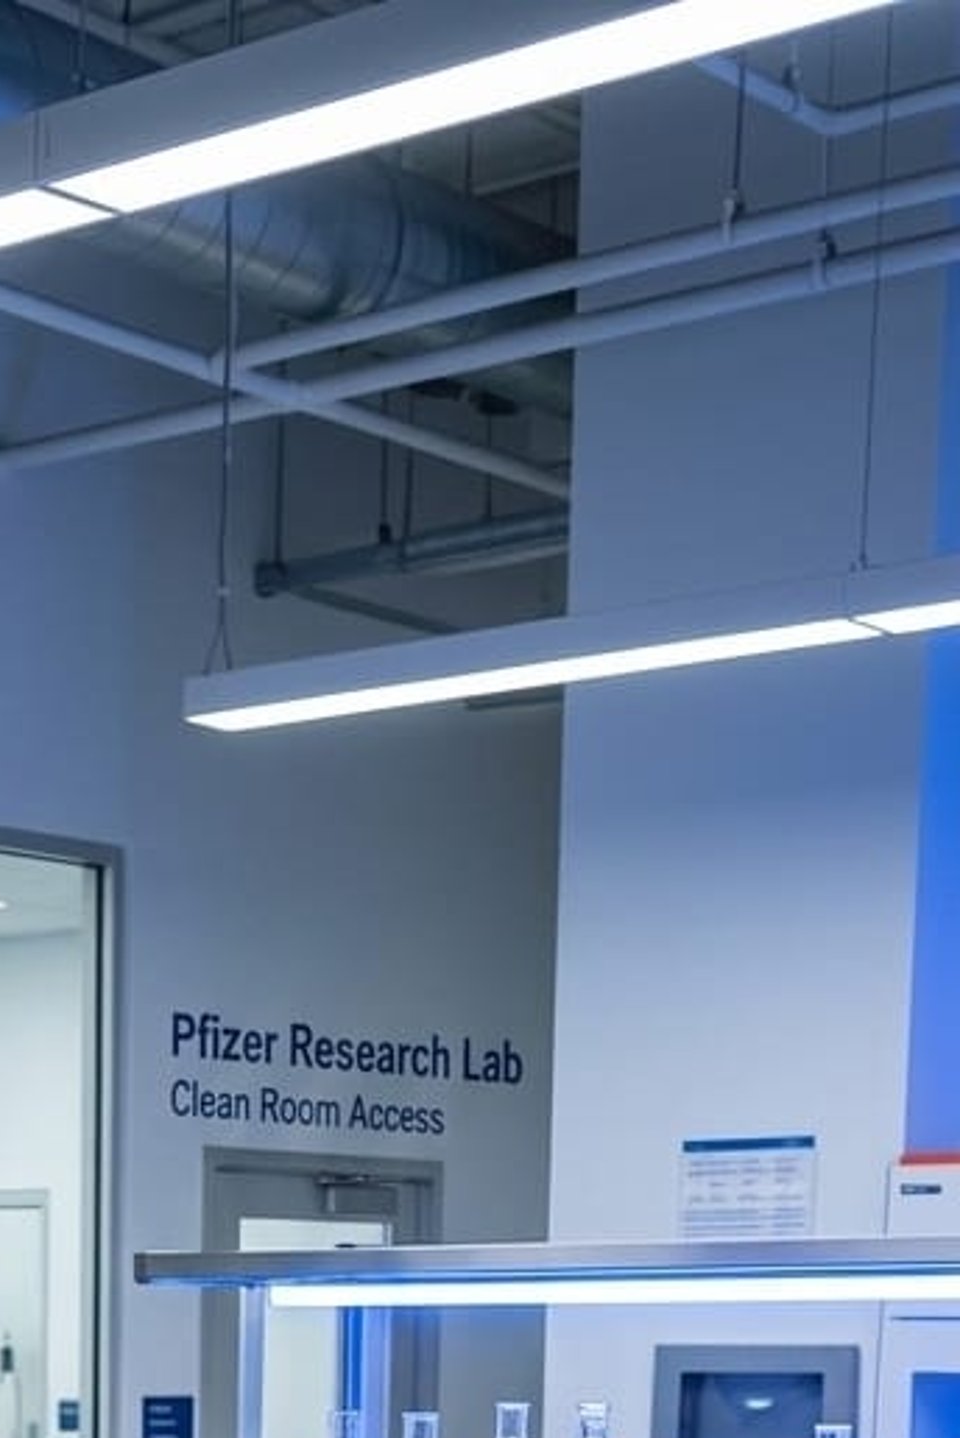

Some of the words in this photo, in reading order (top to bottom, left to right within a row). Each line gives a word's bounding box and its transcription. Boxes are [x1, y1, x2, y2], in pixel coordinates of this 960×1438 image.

[171, 1012, 278, 1064] Pfizer
[289, 1023, 450, 1079] Research
[462, 1036, 523, 1084] Lab
[170, 1079, 250, 1121] Clean
[260, 1087, 339, 1127] Room
[348, 1095, 445, 1135] Access
